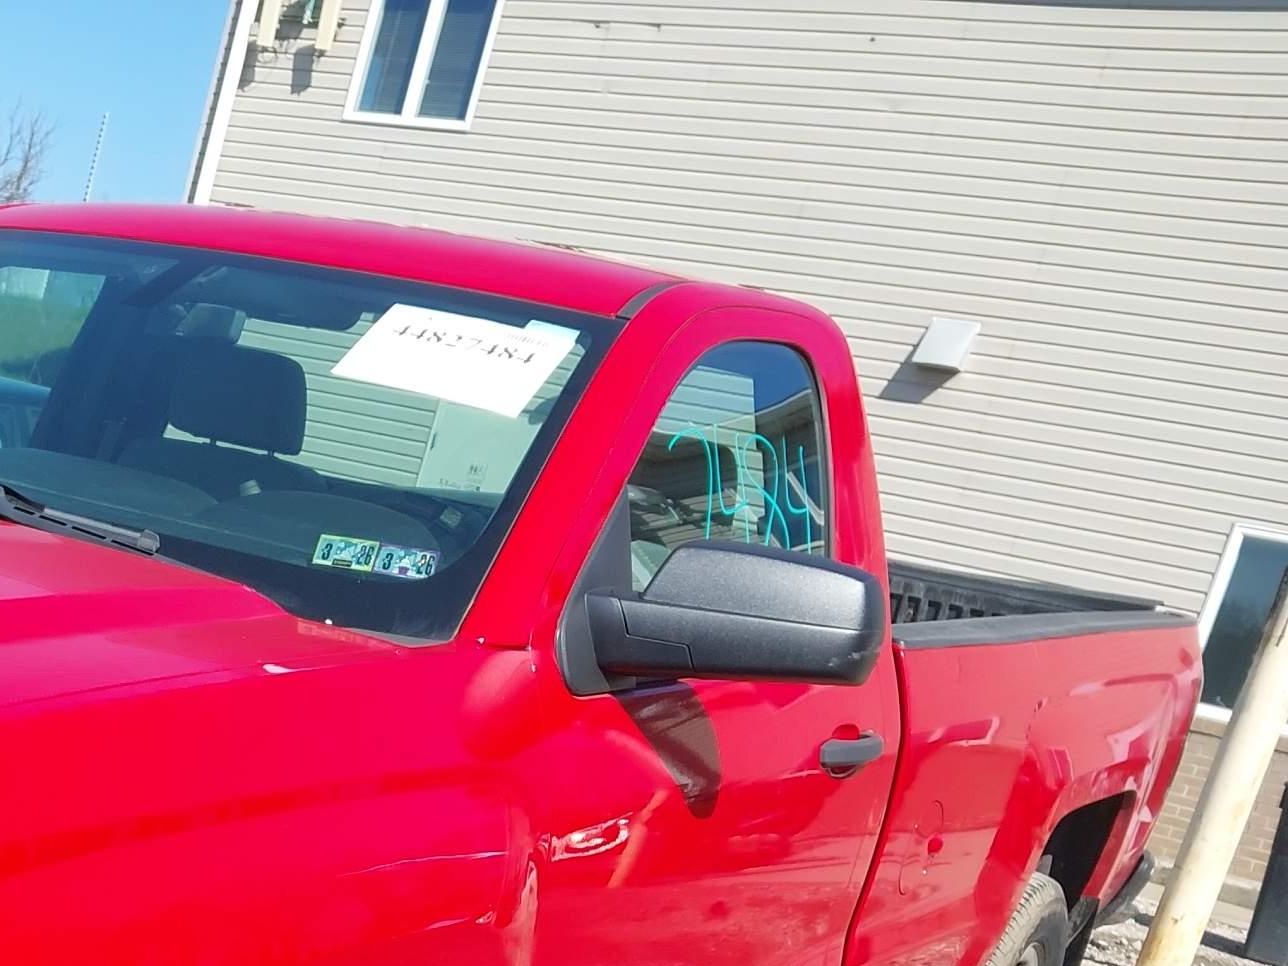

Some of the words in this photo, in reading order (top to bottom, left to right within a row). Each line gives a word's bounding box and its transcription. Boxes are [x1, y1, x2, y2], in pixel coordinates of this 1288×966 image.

[392, 323, 536, 365] 44827484
[321, 543, 333, 560] 3
[355, 545, 375, 566] 26
[381, 552, 394, 570] 3
[416, 554, 436, 576] 26
